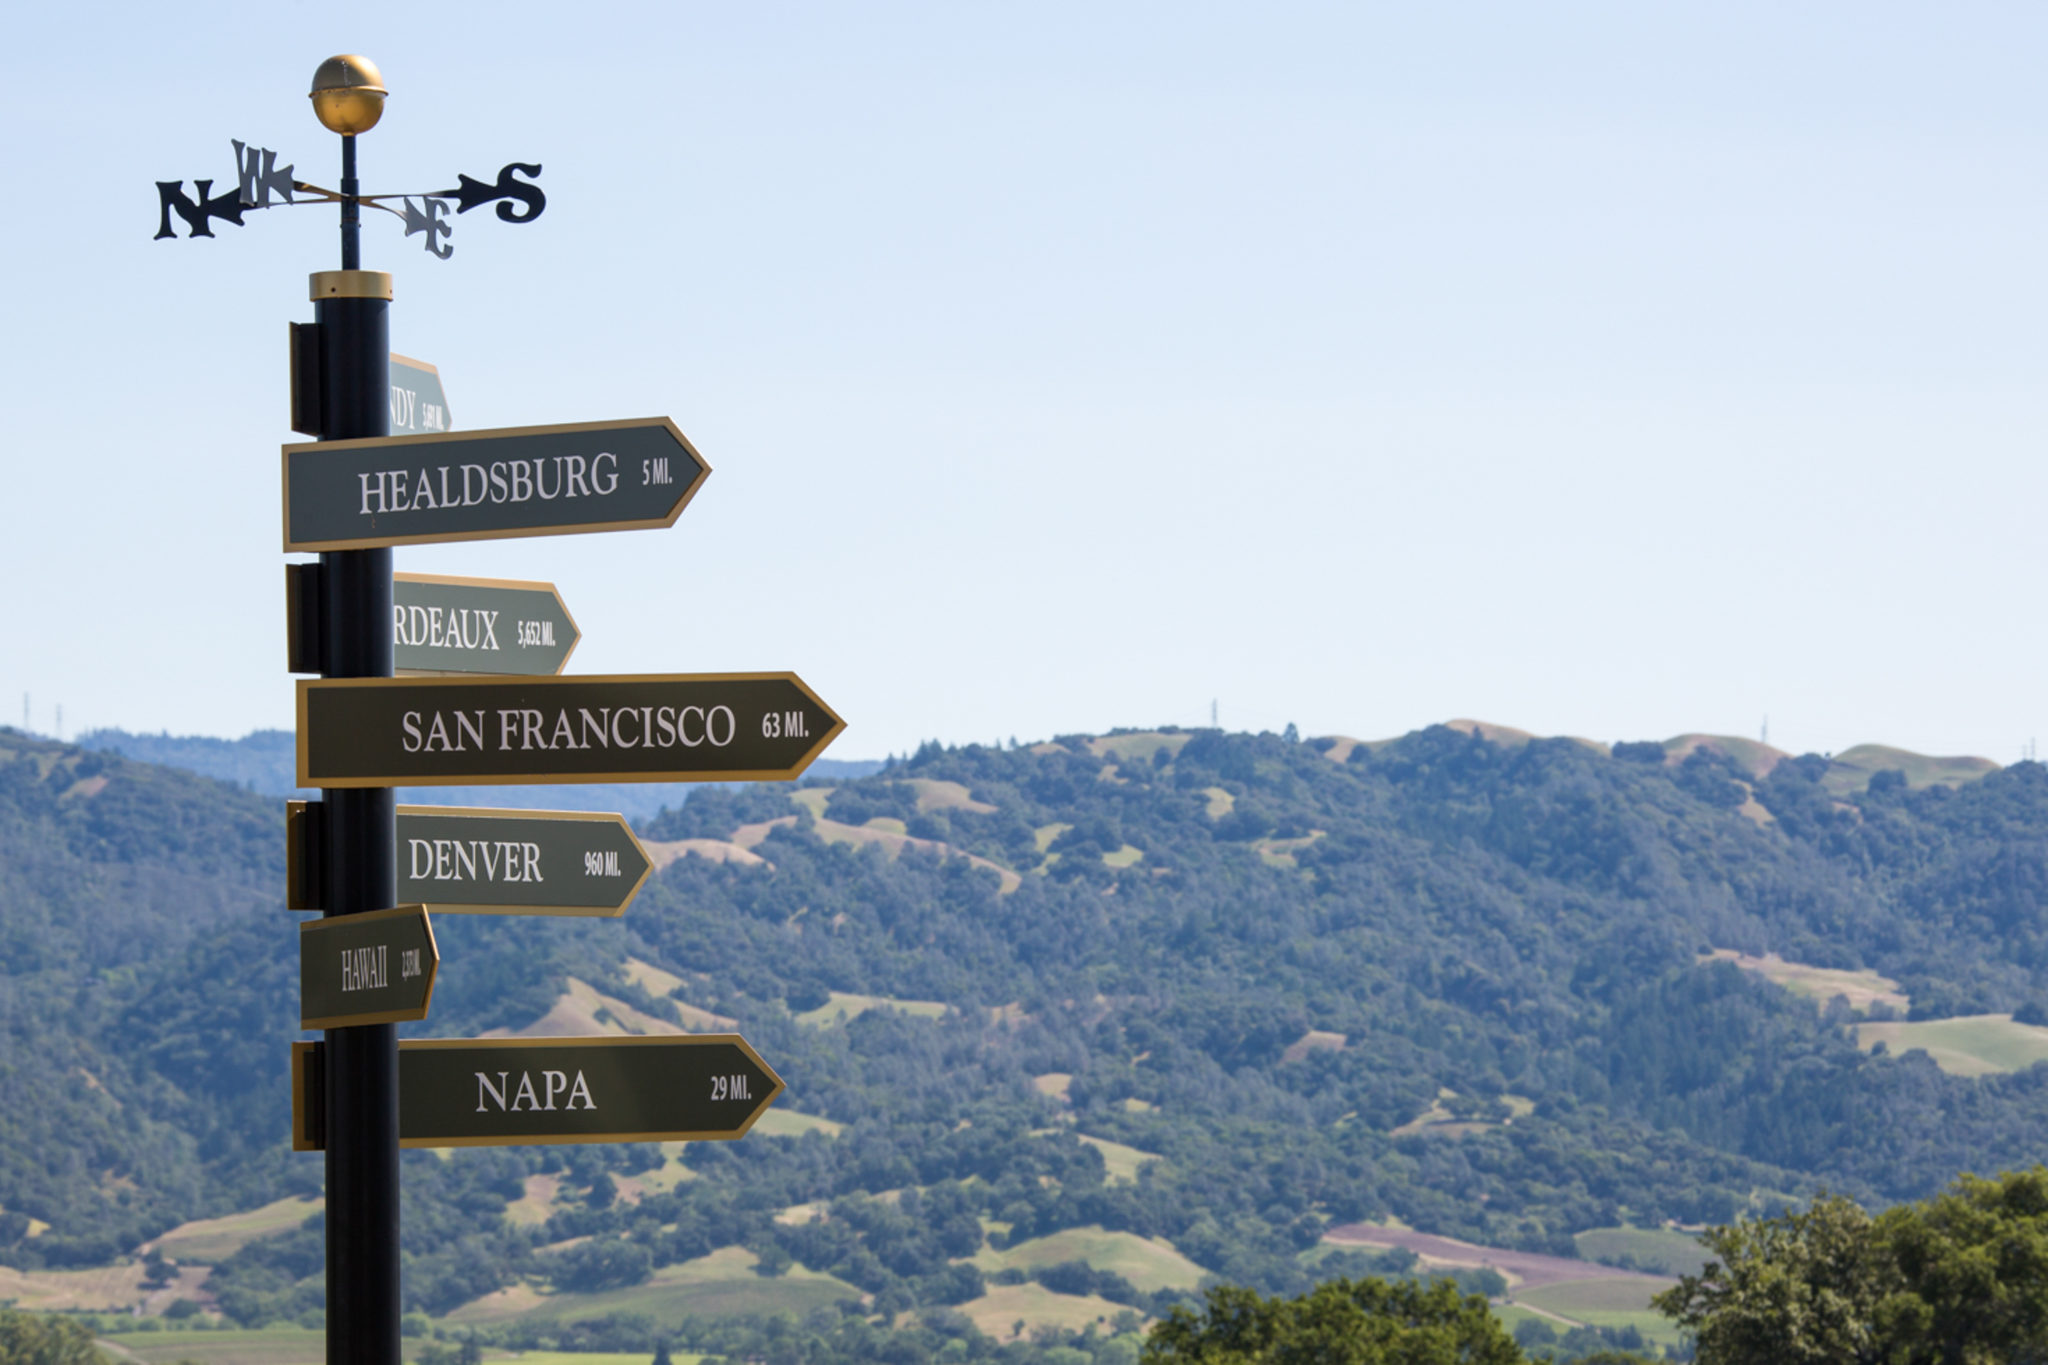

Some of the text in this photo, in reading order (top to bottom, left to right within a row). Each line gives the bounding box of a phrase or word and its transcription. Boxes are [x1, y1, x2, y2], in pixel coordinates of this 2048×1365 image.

[153, 179, 215, 240] N
[496, 162, 547, 223] S
[423, 197, 454, 260] E
[358, 452, 673, 514] HEALDSBURG 5 MI.
[517, 619, 541, 649] 5,652
[541, 620, 556, 647] MI.
[402, 705, 809, 752] SAN FRANCISCO 63 MI.
[408, 839, 621, 882] DENVER 960 MI.
[341, 944, 388, 992] HAWAII
[475, 1069, 752, 1112] NAPA 29 MI.
